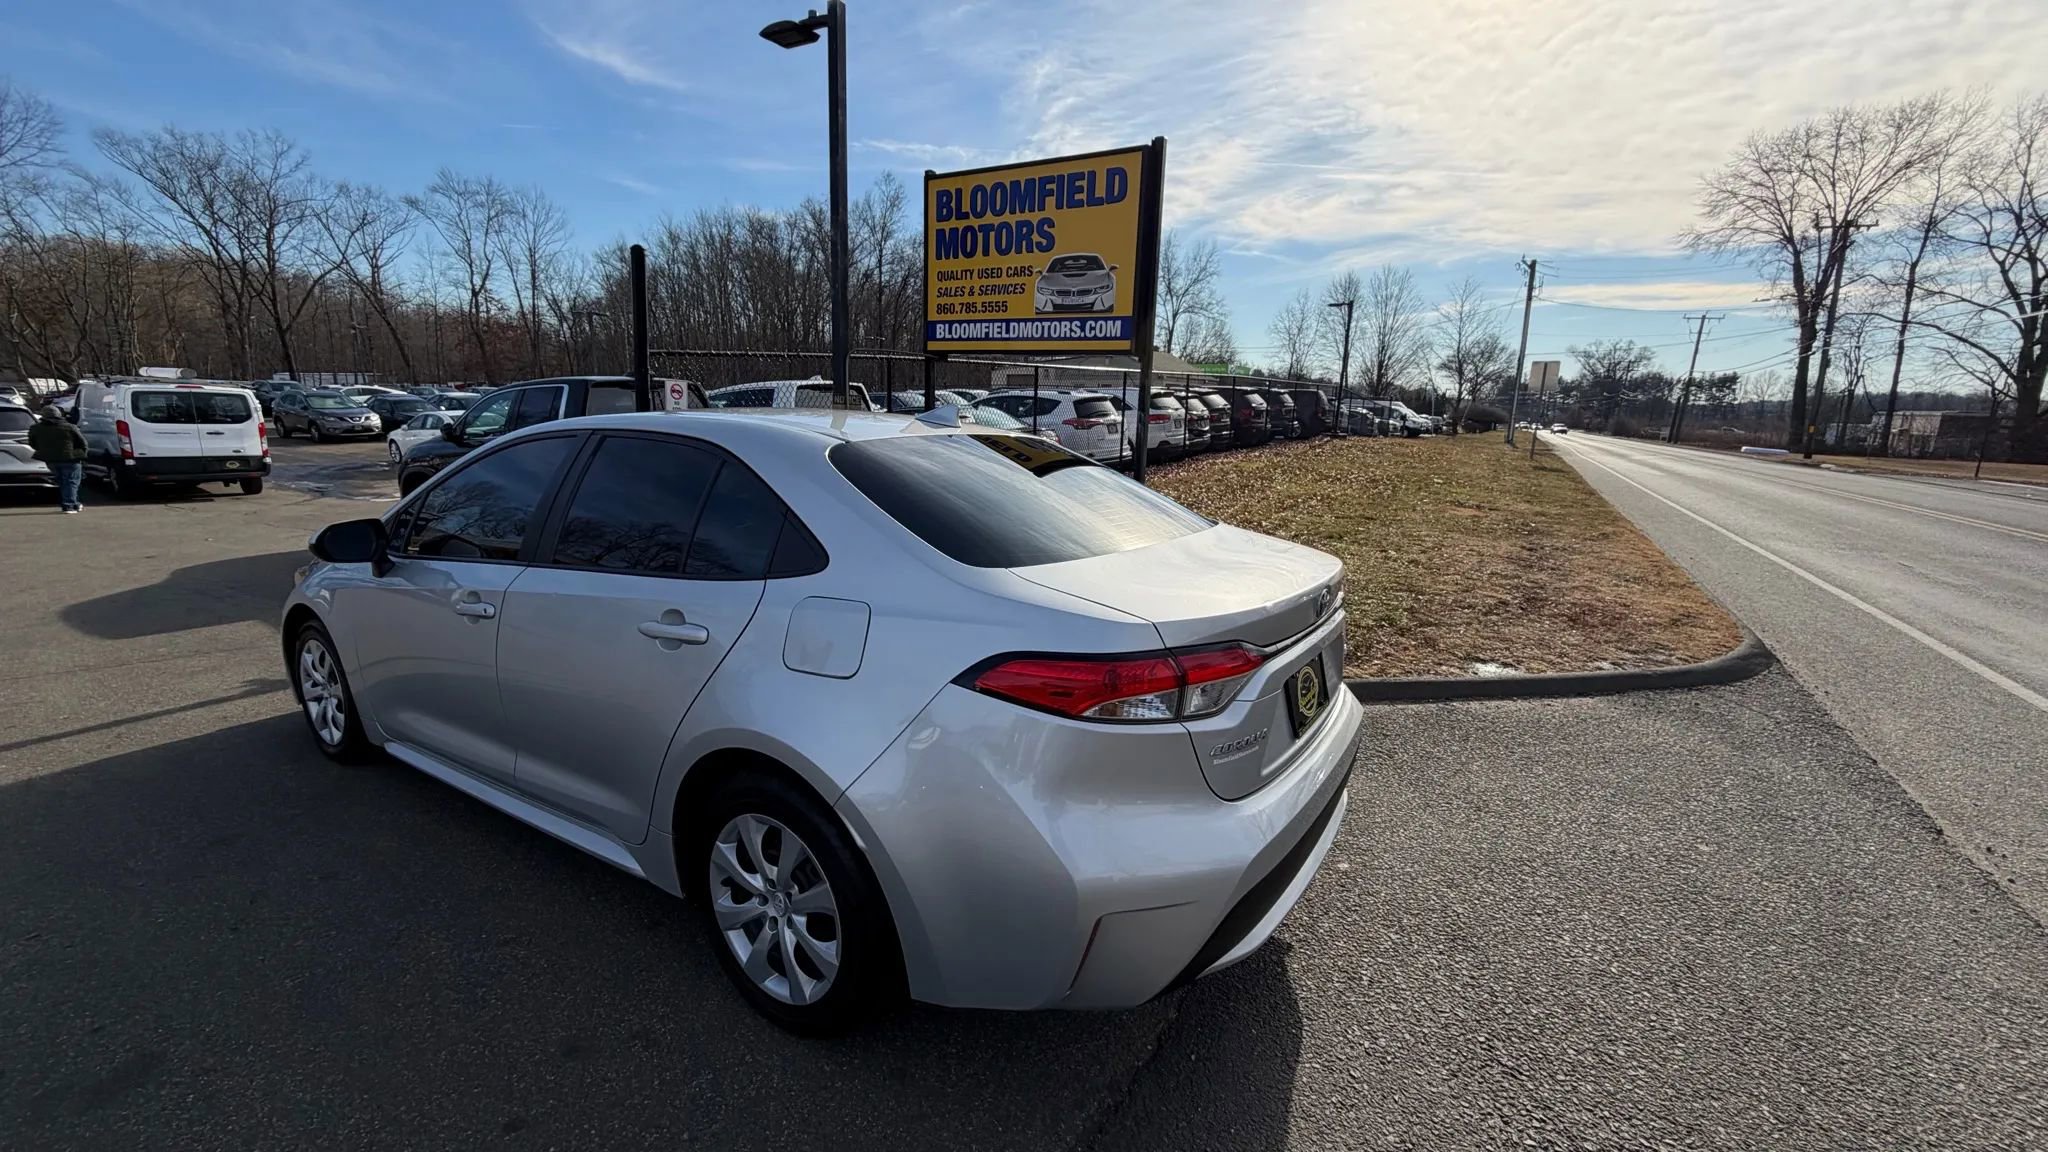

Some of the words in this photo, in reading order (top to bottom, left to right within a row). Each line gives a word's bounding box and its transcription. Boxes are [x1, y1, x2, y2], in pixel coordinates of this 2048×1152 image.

[935, 166, 1128, 223] BLOOMFIELD
[935, 217, 1056, 261] MOTORS
[936, 268, 974, 282] QUALITY
[977, 267, 1002, 280] USED
[1005, 265, 1033, 278] CARS
[936, 286, 966, 298] SALES
[968, 285, 975, 297] &
[978, 283, 1026, 296] SERVICES
[936, 301, 1008, 315] 860.785.5555
[936, 320, 1121, 339] BLOOMFIELDMOTORS.COM
[834, 394, 862, 405] NOICE
